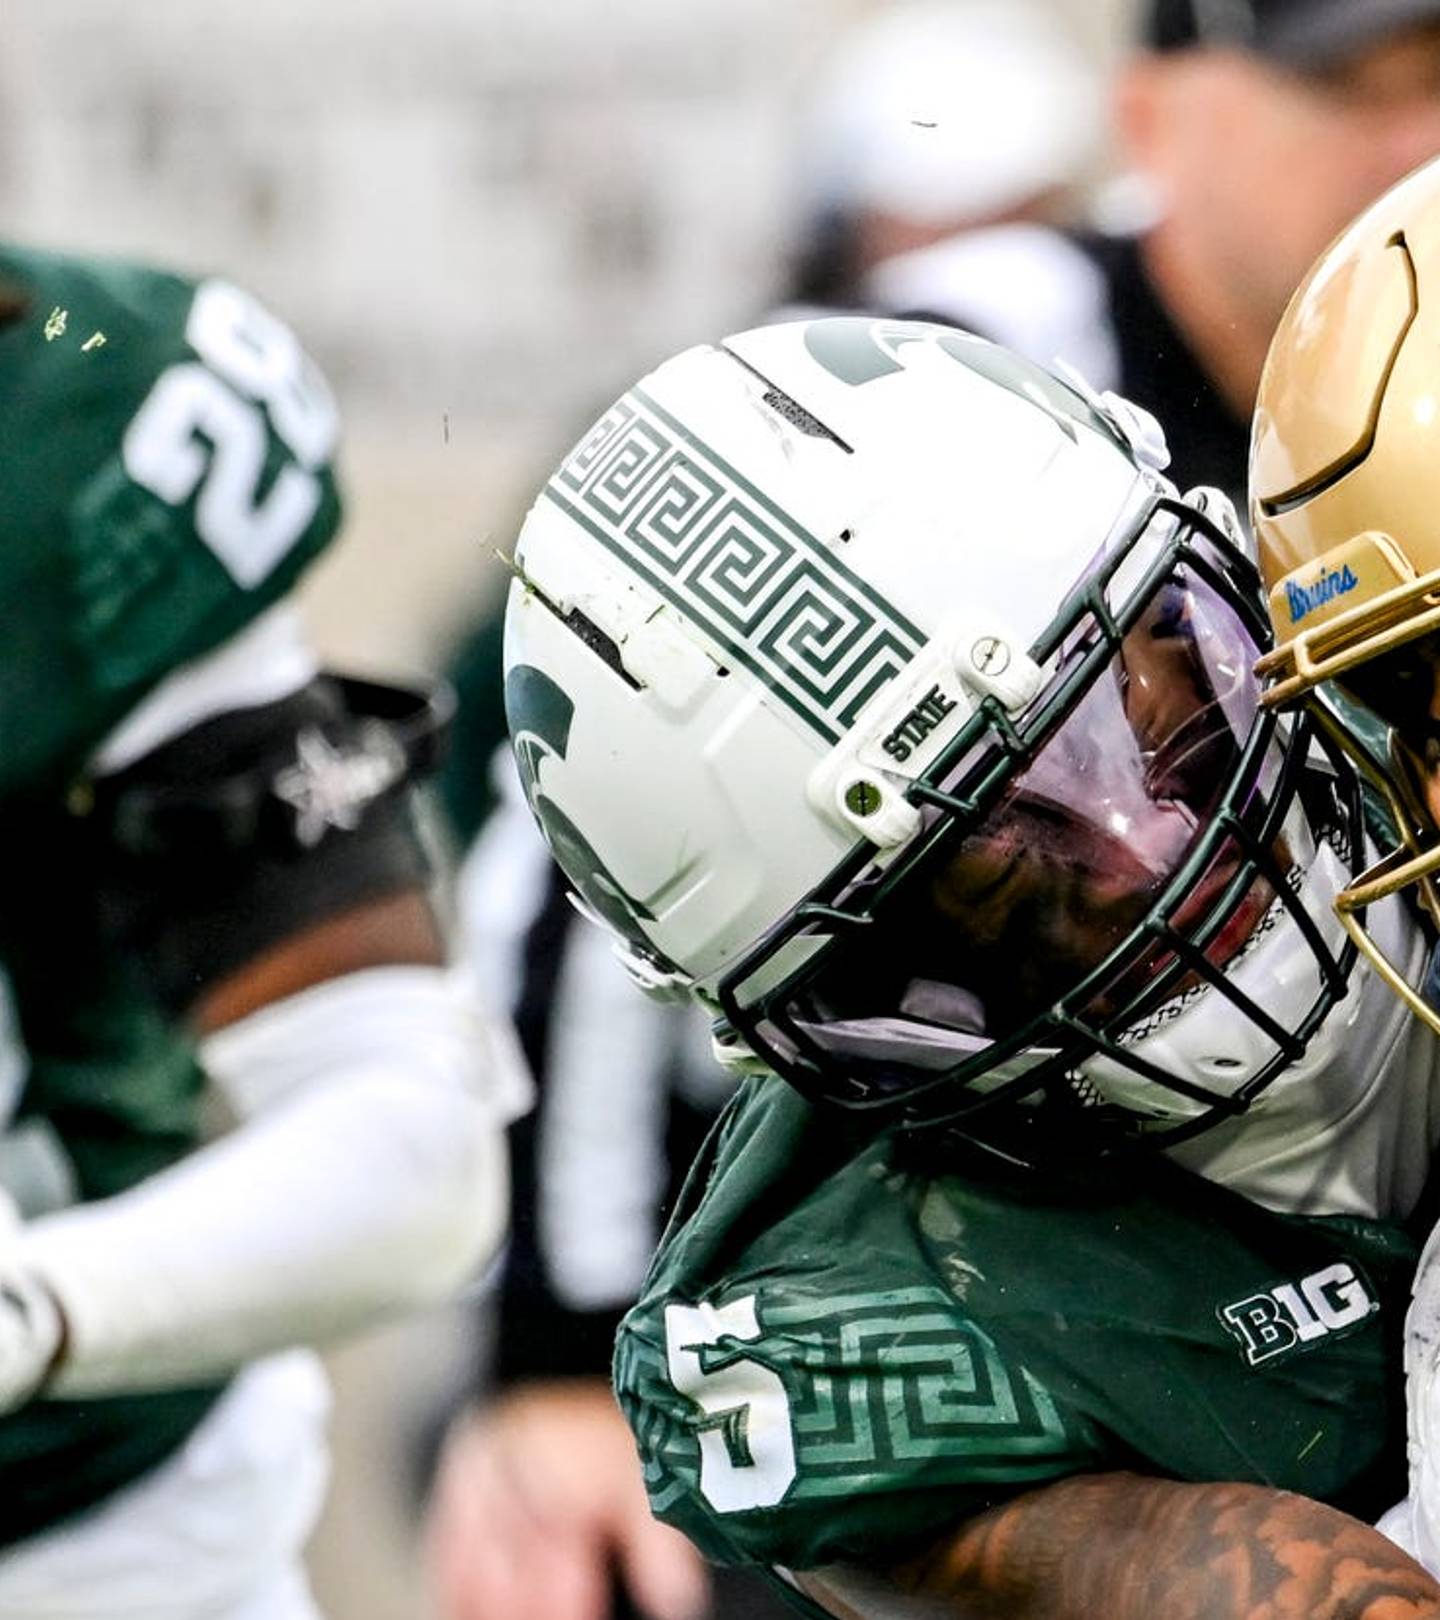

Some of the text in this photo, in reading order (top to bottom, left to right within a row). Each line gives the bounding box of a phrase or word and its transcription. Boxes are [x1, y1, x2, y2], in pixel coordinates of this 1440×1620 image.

[122, 279, 341, 590] 28
[1284, 564, 1358, 624] Bruins
[882, 683, 958, 763] STATE
[665, 1294, 797, 1513] 5
